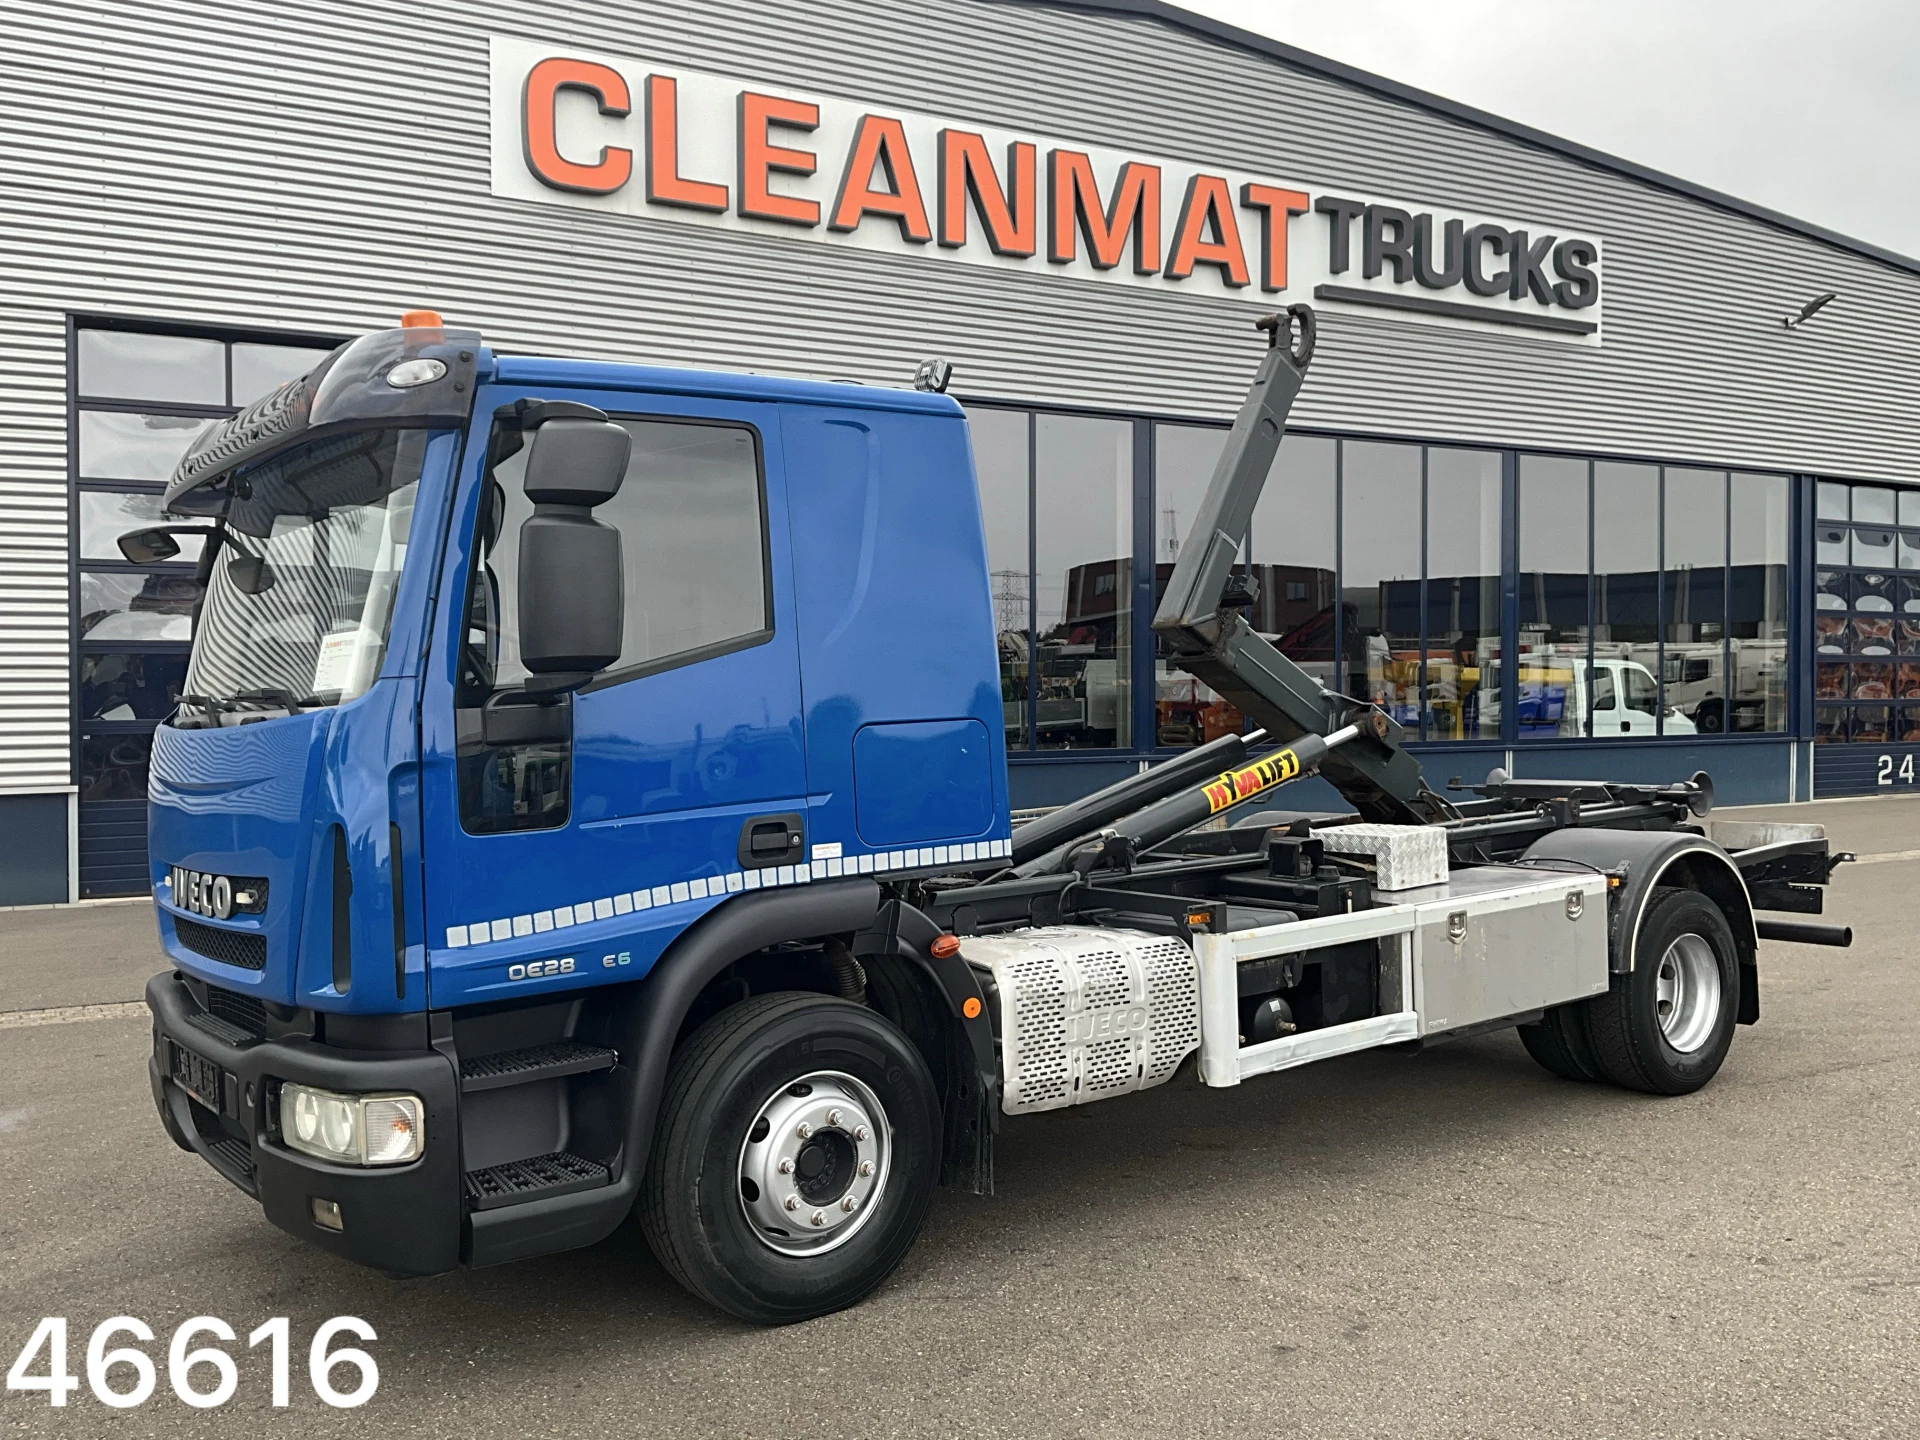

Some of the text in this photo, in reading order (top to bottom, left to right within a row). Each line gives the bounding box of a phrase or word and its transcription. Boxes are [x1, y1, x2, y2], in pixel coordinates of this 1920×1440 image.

[521, 56, 1599, 310] CLEANMAT TRUCKS
[1878, 754, 1915, 785] 24
[172, 866, 232, 920] IVECO
[602, 951, 631, 968] E6
[1067, 1006, 1148, 1042] IVECO
